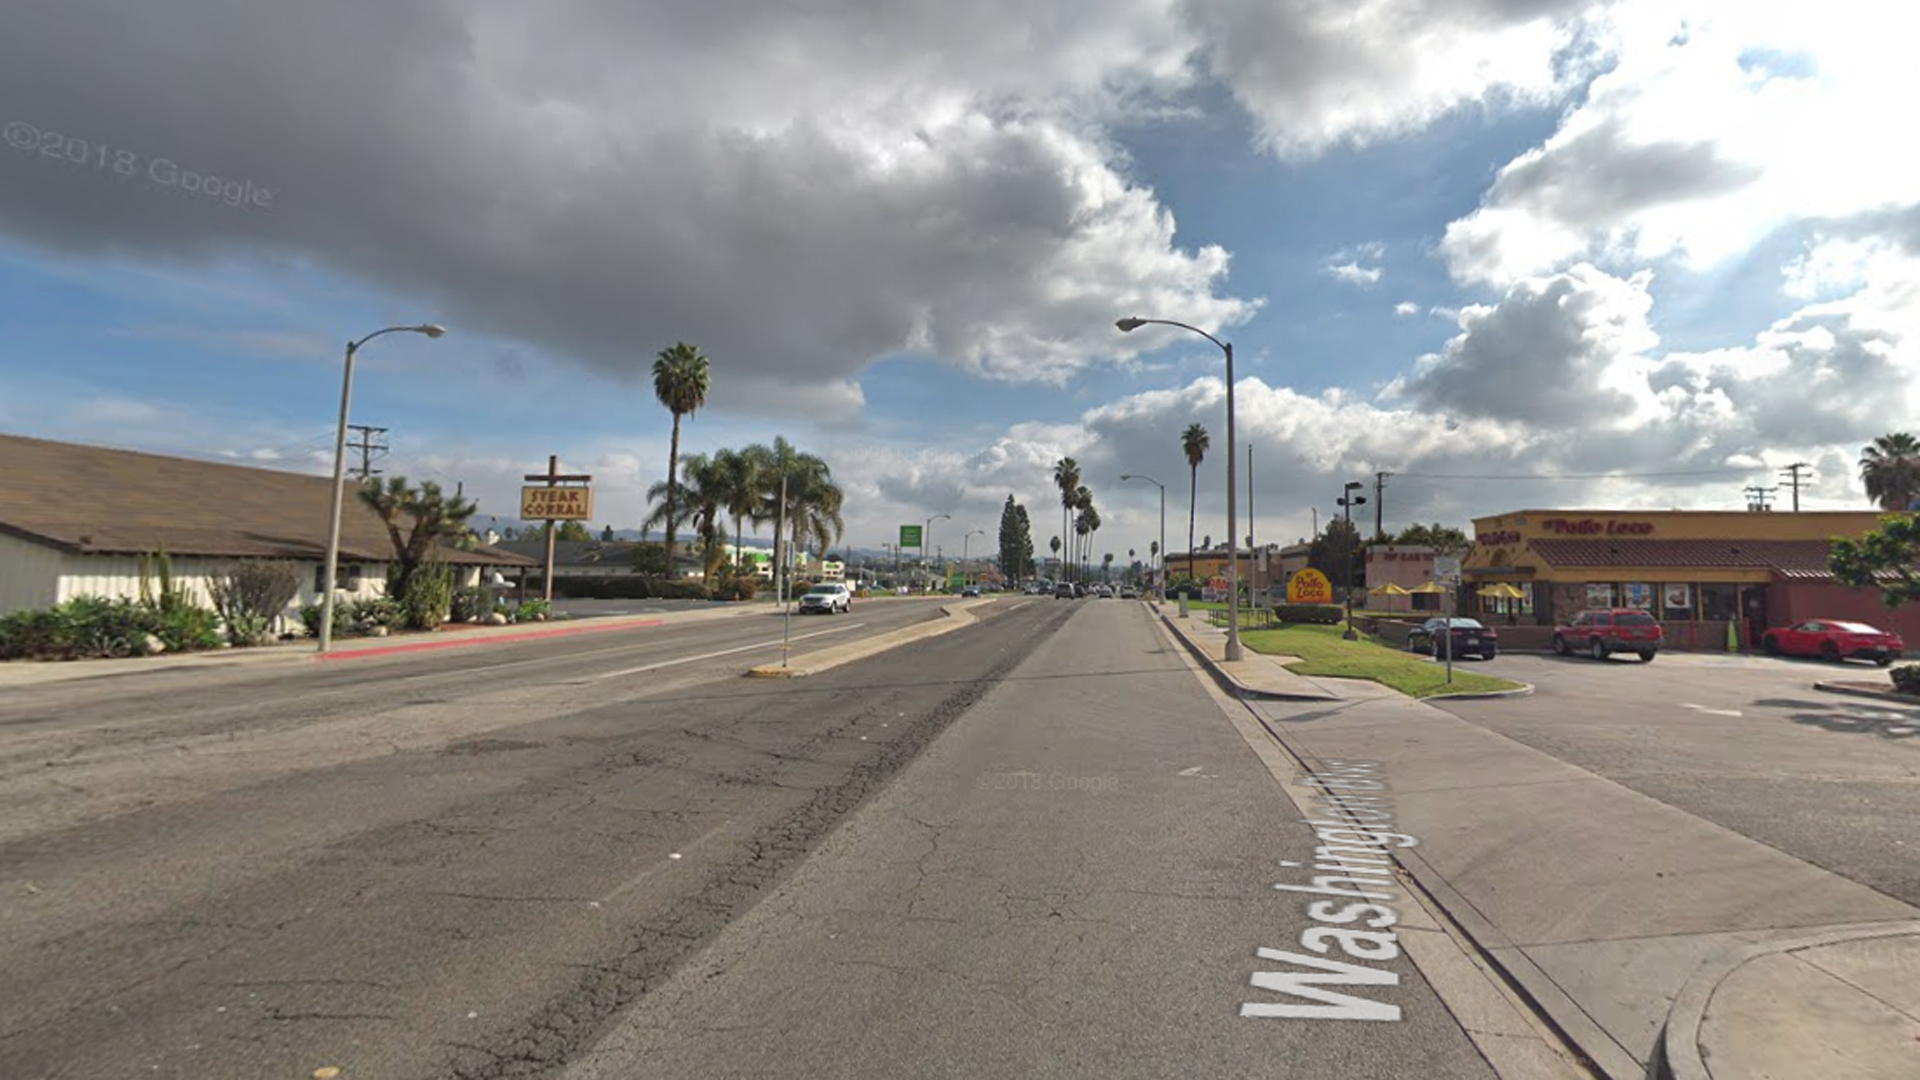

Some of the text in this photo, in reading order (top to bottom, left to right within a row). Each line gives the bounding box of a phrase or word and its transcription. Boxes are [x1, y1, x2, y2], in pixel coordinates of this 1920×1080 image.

[531, 490, 579, 502] STEAK
[524, 503, 586, 516] CORRAL
[1606, 519, 1655, 535] Loco
[1296, 576, 1324, 589] Pollo
[1297, 588, 1324, 599] Loco
